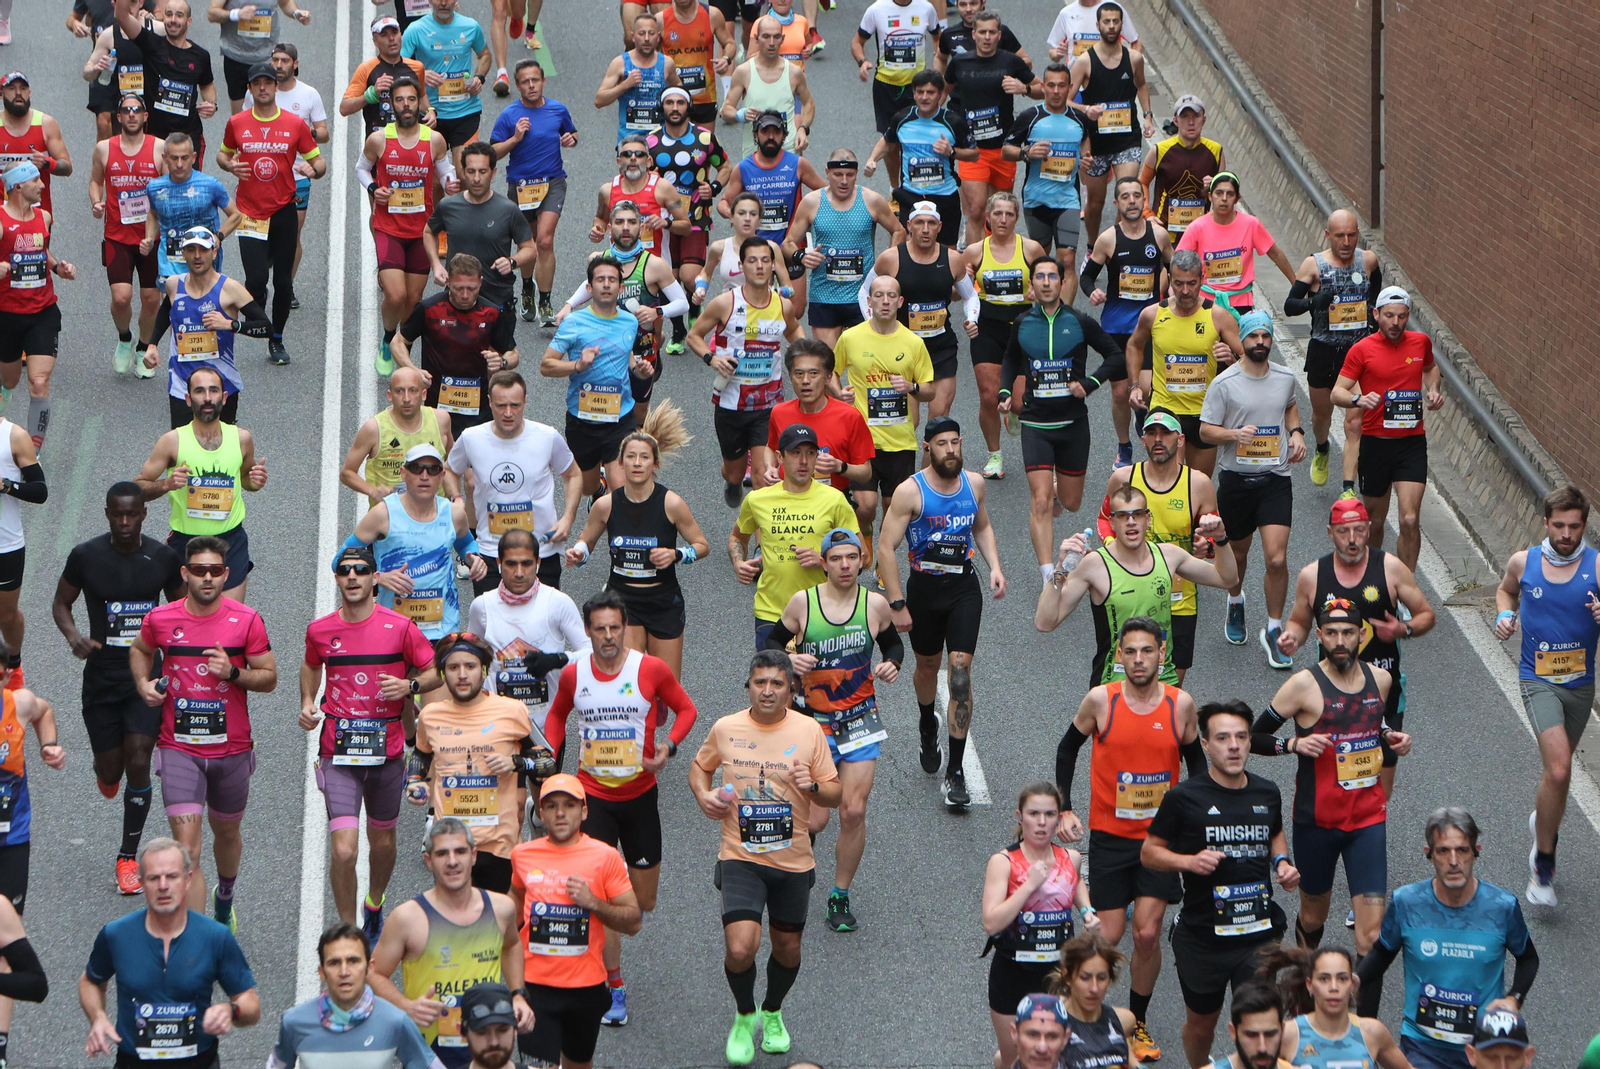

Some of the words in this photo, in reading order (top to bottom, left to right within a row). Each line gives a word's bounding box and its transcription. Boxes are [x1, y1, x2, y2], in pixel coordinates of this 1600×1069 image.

[172, 83, 190, 91] ZURICH
[975, 109, 995, 117] ZURICH
[401, 181, 421, 189] ZURICH
[766, 182, 795, 191] CARRERAS
[1216, 251, 1237, 259] ZURICH
[1342, 294, 1362, 302] ZURICH
[922, 303, 942, 312] ZURICH
[501, 504, 527, 512] ZURICH
[772, 513, 815, 521] TRIATLÓN
[771, 525, 815, 534] BLANCA
[943, 534, 966, 542] ZURICH
[625, 552, 641, 560] 3371
[404, 562, 438, 578] RUNNING
[124, 602, 153, 610] ZURICH
[124, 617, 142, 626] 3200
[818, 630, 867, 653] MOJAMAS
[1552, 641, 1581, 650] ZURICH
[1552, 656, 1570, 665] 4157
[191, 701, 219, 709] ZURICH
[597, 706, 639, 715] TRIATLÓN
[189, 716, 208, 724] 2475
[584, 714, 630, 722] ALGECIRAS
[352, 720, 381, 728] ZURICH
[189, 727, 210, 735] SERRA
[600, 730, 630, 739] ZURICH
[848, 728, 871, 741] ARTOLA
[350, 736, 369, 744] 2619
[1354, 739, 1378, 750] ZURICH
[346, 747, 373, 755] GUILLEM
[595, 758, 624, 766] MORALES
[733, 759, 760, 768] Maratón
[1354, 756, 1371, 765] 4343
[459, 778, 491, 786] ZURICH
[1136, 774, 1165, 783] ZURICH
[460, 794, 479, 803] 5523
[755, 806, 785, 815] ZURICH
[755, 823, 775, 832] 2781
[762, 833, 784, 843] BENITO
[1205, 824, 1270, 843] FINISHER
[1233, 885, 1262, 895] ZURICH
[550, 906, 584, 915] ZURICH
[1233, 903, 1254, 912] 3097
[1038, 912, 1067, 922] ZURICH
[548, 923, 570, 933] 3462
[1036, 929, 1056, 939] 2894
[549, 937, 569, 945] DANO
[1438, 988, 1473, 1003] ZURICH
[1435, 1006, 1458, 1020] 3419
[151, 1038, 183, 1049] RICHARD
